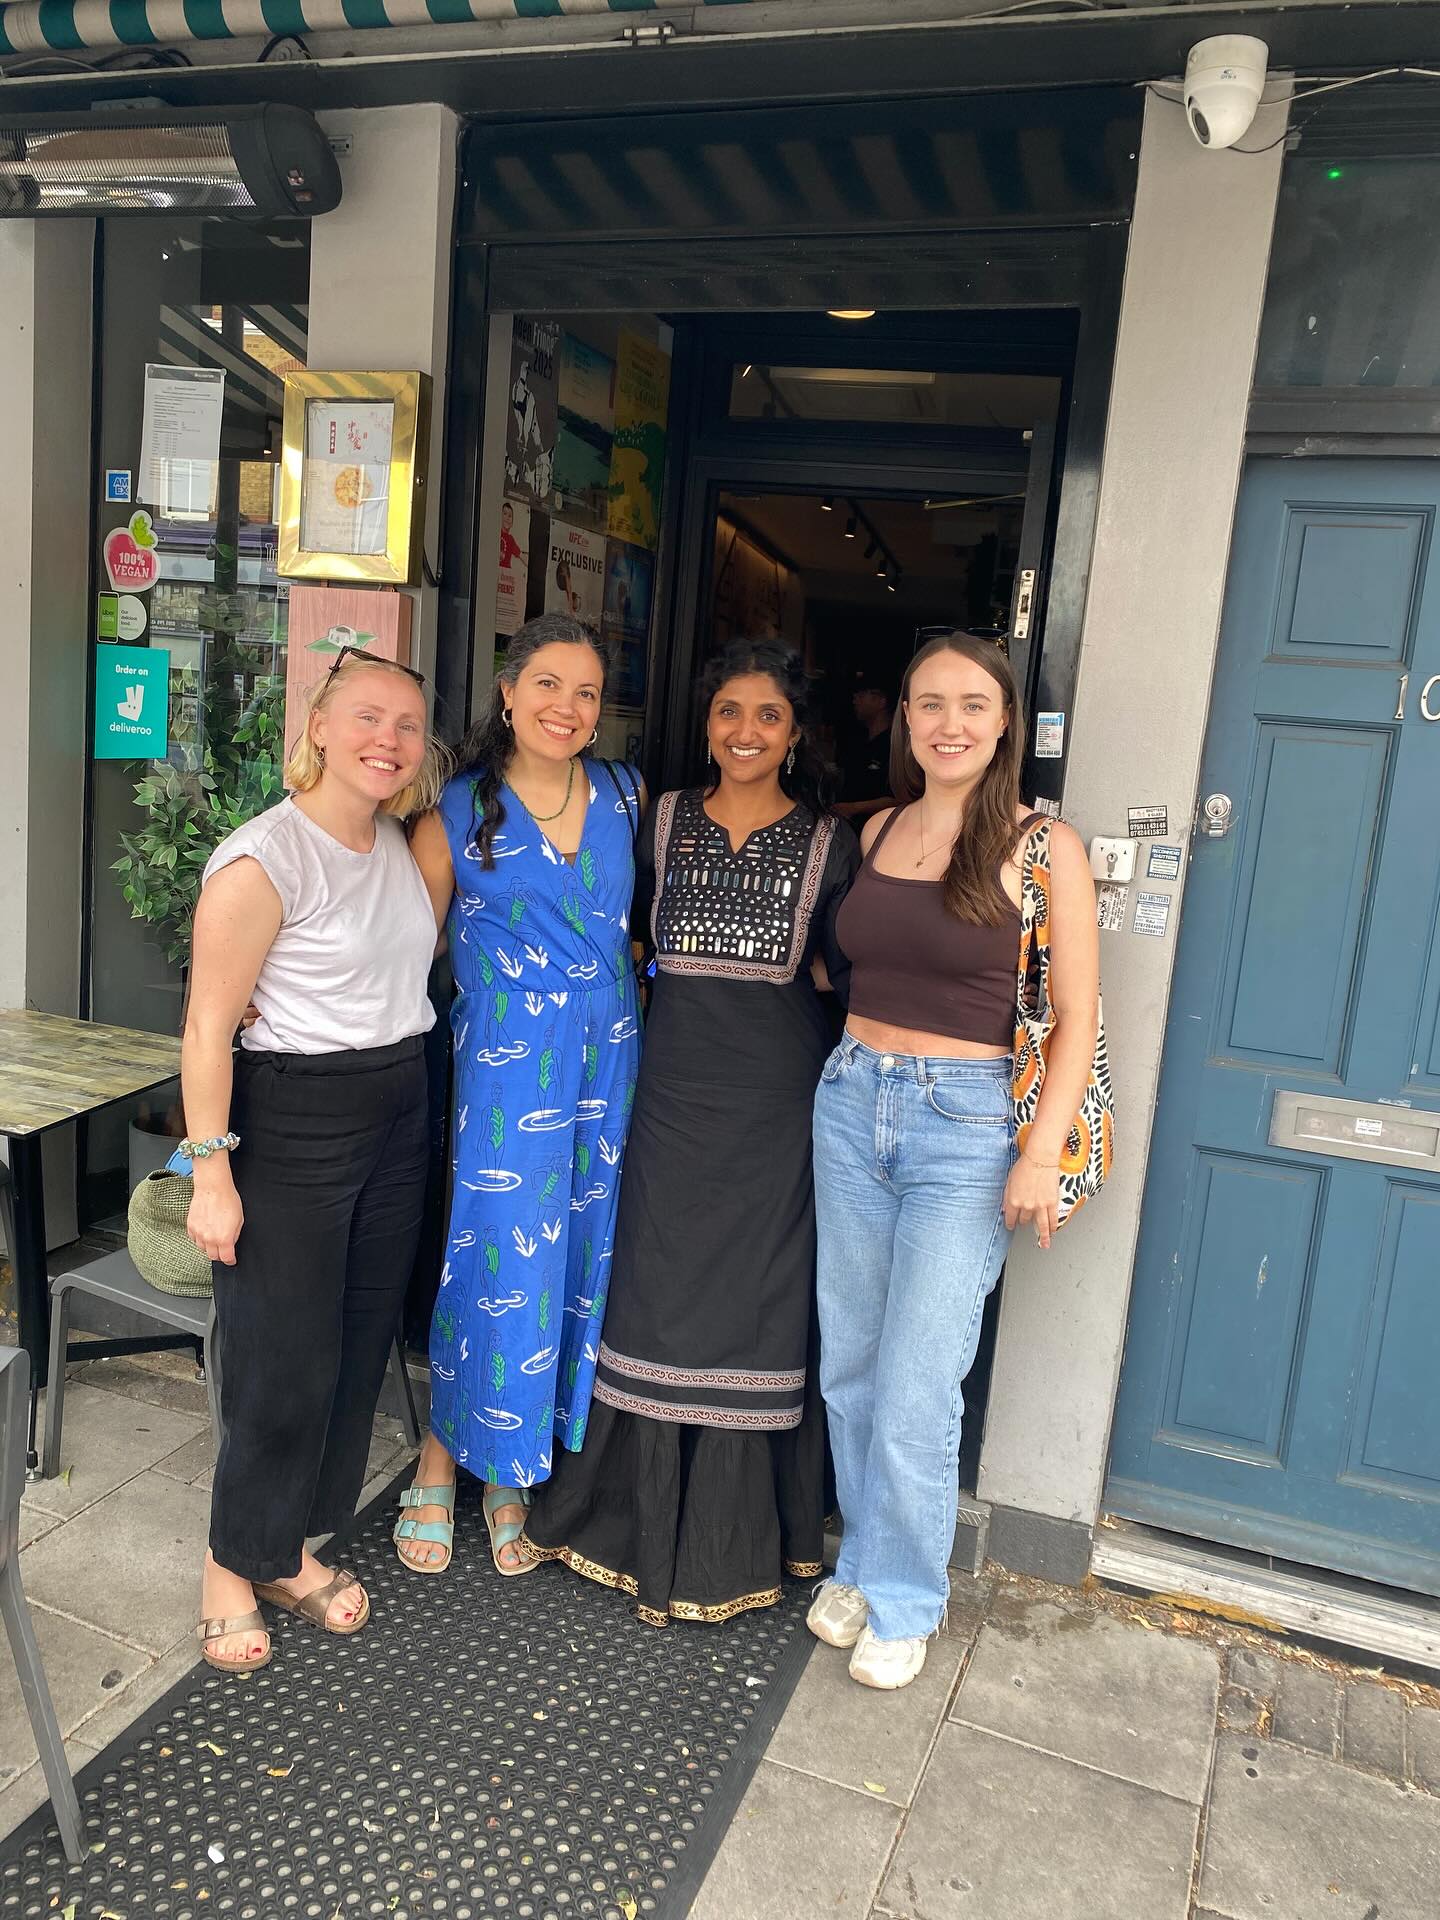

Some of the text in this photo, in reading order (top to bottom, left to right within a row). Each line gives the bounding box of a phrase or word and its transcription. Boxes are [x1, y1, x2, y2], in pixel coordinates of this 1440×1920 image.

[114, 477, 128, 486] AM
[116, 485, 128, 495] EX
[118, 552, 146, 567] 100%
[551, 545, 604, 575] EXCLUSIVE
[113, 564, 150, 579] VEGAN
[115, 664, 149, 676] Order on
[109, 722, 153, 736] deliveroo
